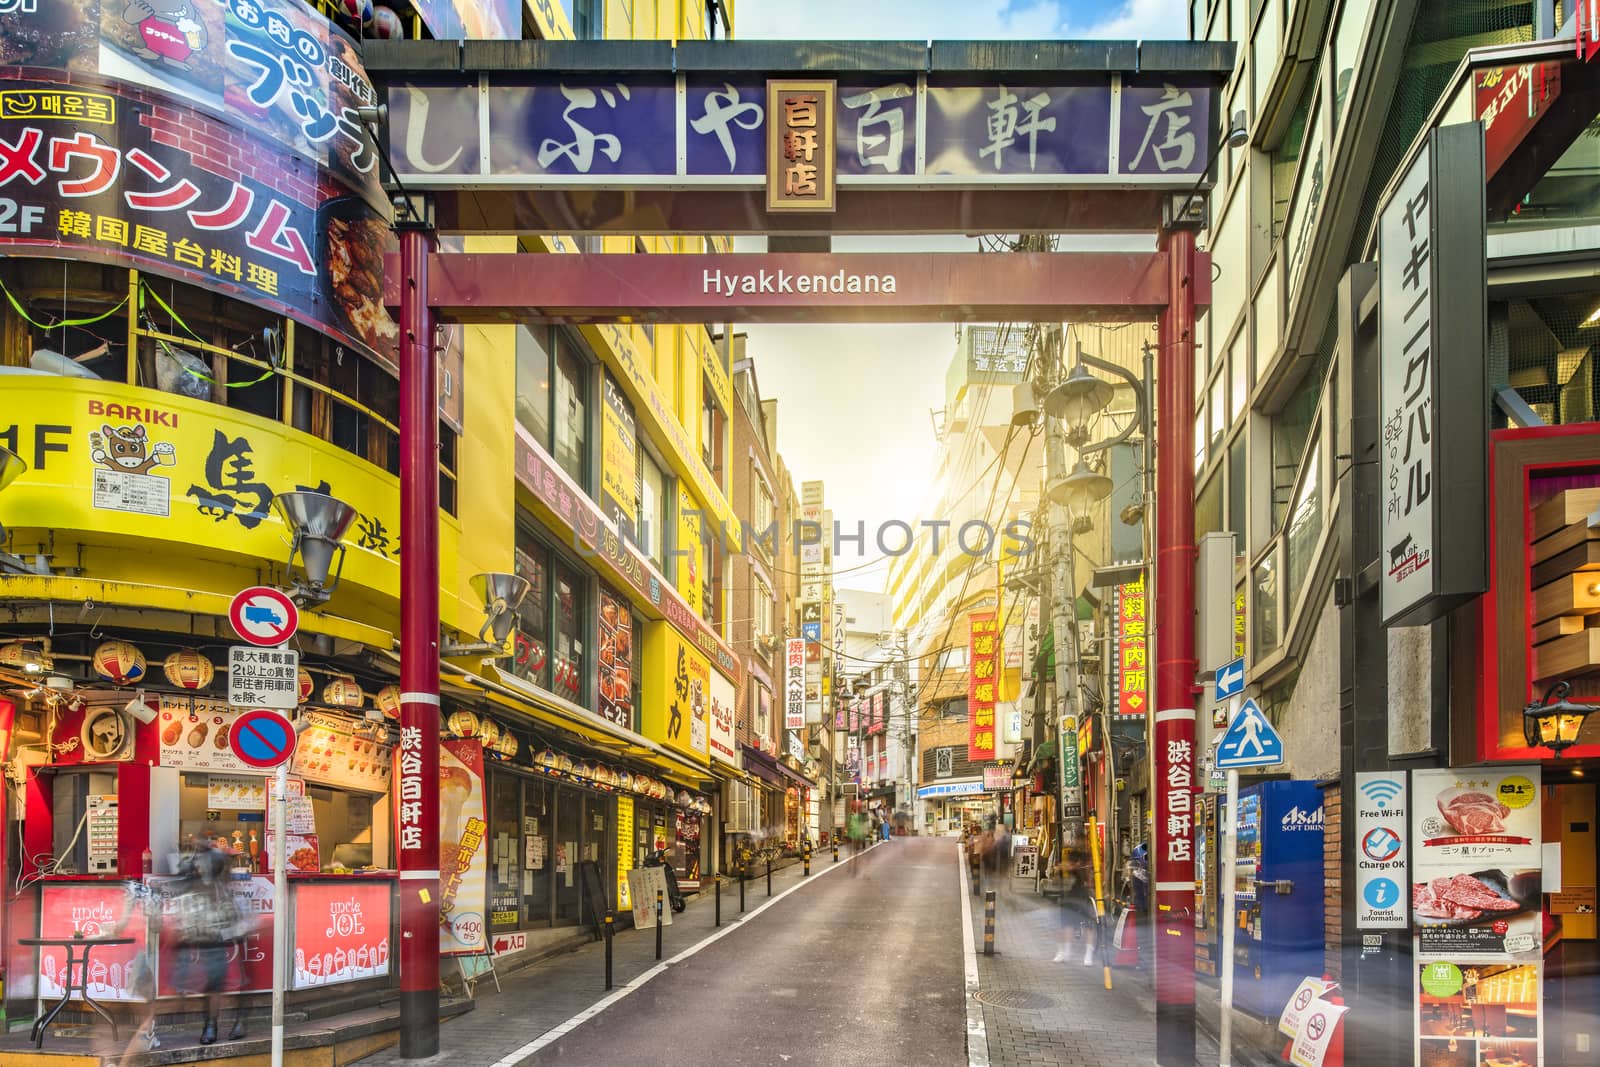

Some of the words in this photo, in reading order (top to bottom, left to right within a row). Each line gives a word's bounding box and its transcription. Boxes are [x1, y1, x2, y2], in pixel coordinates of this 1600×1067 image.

[236, 0, 318, 60] お肉の
[42, 94, 109, 119] 매운놈
[784, 95, 818, 197] 百軒店
[0, 127, 317, 274] メウンノム
[0, 202, 45, 233] 2F
[58, 209, 279, 296] 韓国屋台料理
[702, 269, 896, 297] Hyakkendana
[1402, 182, 1431, 517] ヤキニクバル
[88, 400, 178, 428] BARIKI
[357, 513, 400, 558] 渋
[688, 589, 695, 608] 3F
[666, 598, 697, 633] KOREAN
[233, 651, 295, 665] 最大積載量
[232, 678, 295, 692] 居住者用車両
[787, 640, 803, 715] 焼肉食べ放題
[232, 692, 266, 703] を除く
[615, 705, 628, 727] 2F
[401, 726, 423, 850] 渋谷百軒店
[1167, 740, 1191, 862] 渋谷百軒店
[1360, 810, 1379, 818] Free
[1359, 861, 1391, 870] Charge
[1392, 861, 1405, 869] OK
[72, 901, 113, 921] uncle
[329, 897, 361, 915] uncle
[325, 911, 366, 938] JOE
[456, 921, 481, 933] ¥400
[463, 933, 476, 941] から
[509, 935, 525, 950] 入口
